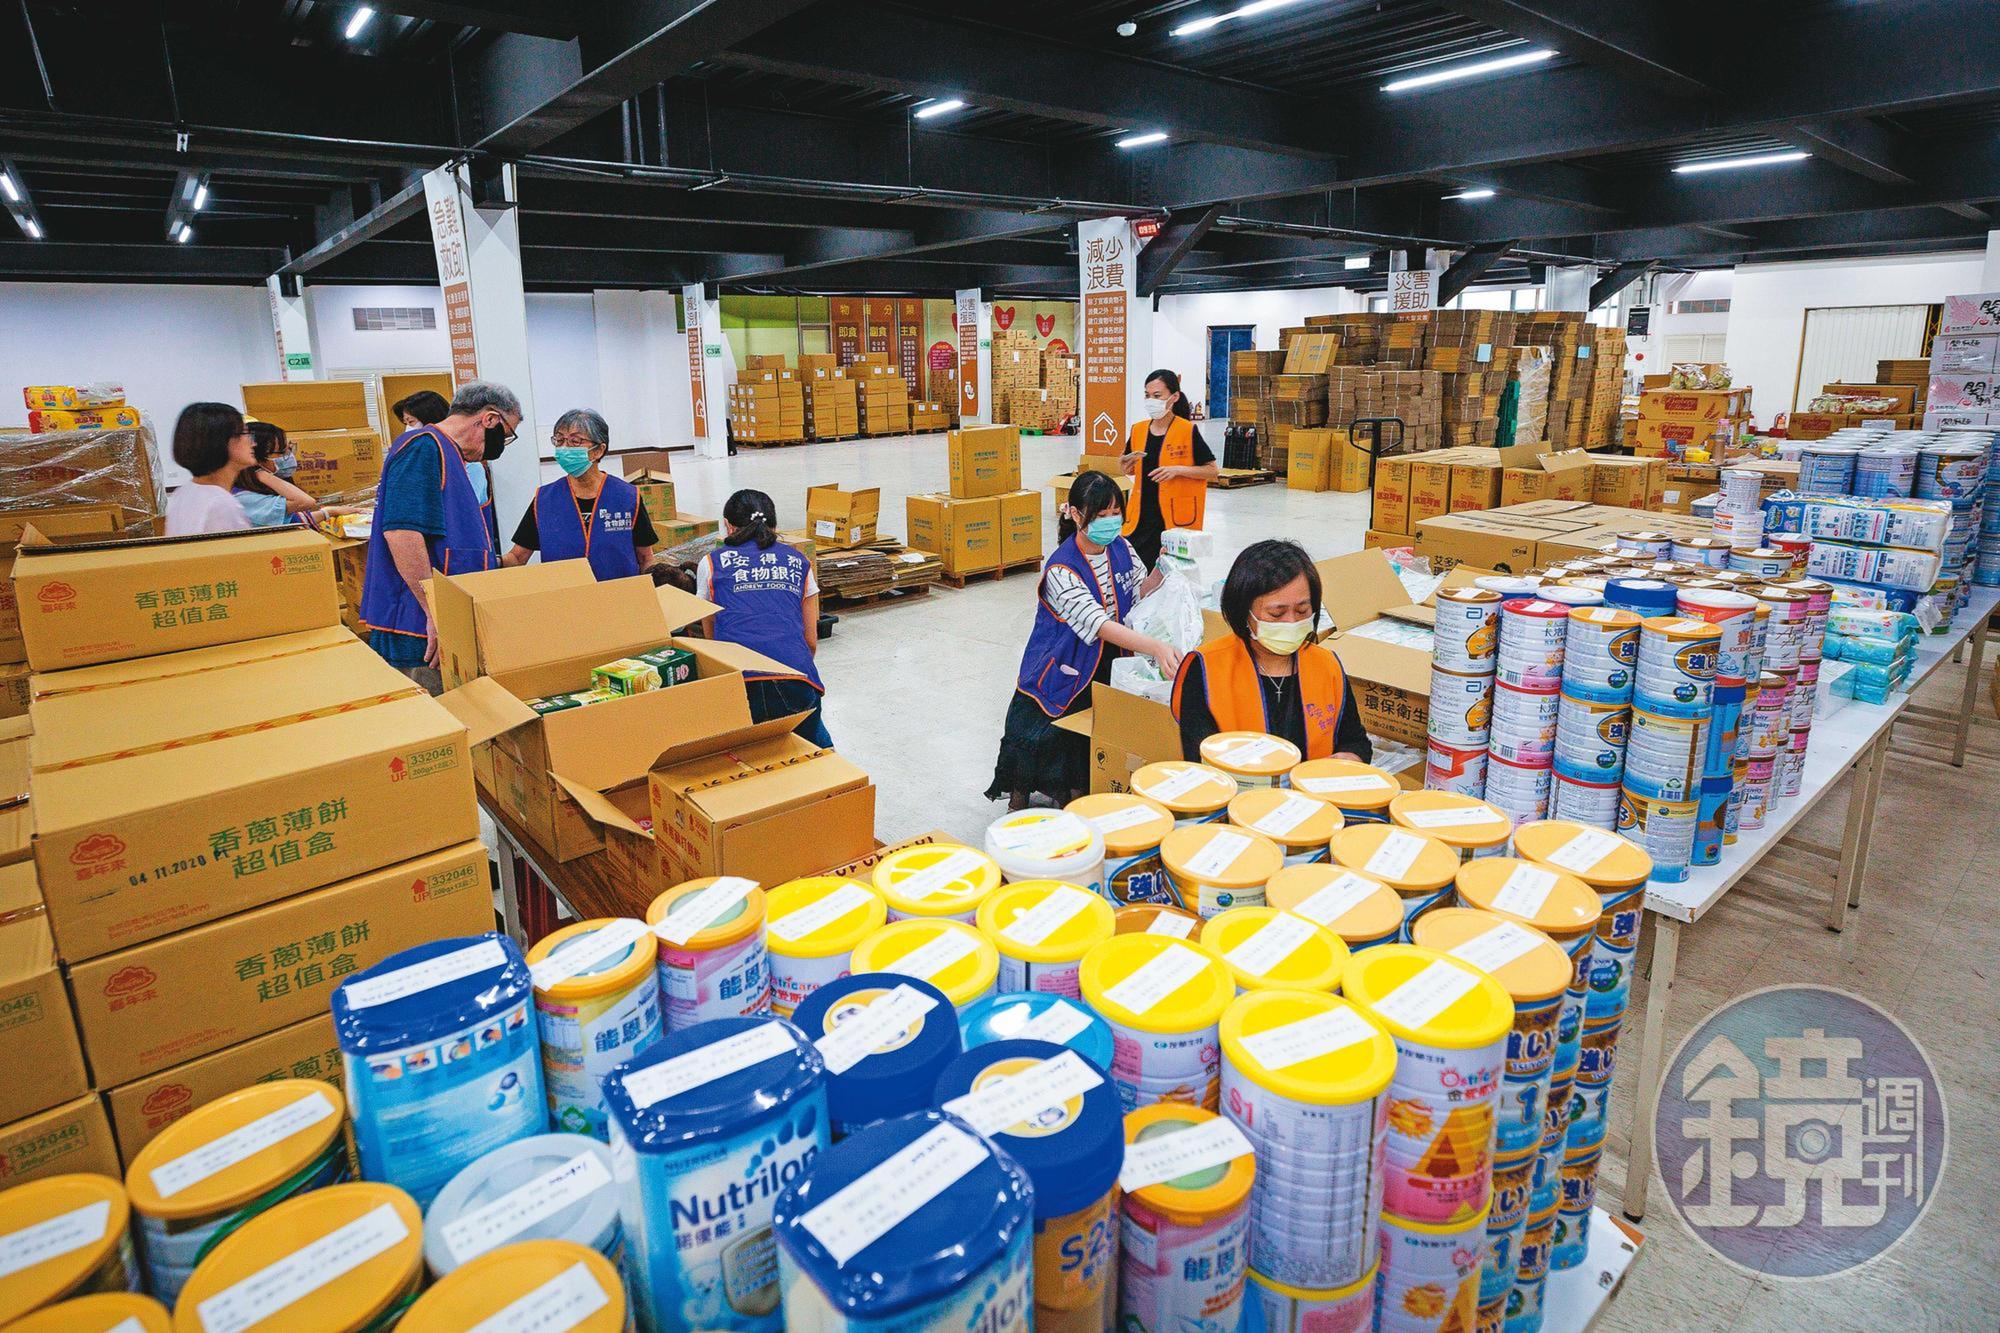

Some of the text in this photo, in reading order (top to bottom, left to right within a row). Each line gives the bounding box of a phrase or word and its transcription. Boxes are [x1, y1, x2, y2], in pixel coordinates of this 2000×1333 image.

[1086, 236, 1124, 263] 減少
[1086, 263, 1125, 290] 浪費
[1394, 271, 1430, 291] 災害
[1393, 291, 1430, 310] 援助
[733, 549, 803, 570] 安得烈
[733, 567, 803, 588] 食物銀行
[766, 583, 786, 591] FOOD
[134, 580, 240, 610] 香蔥薄餅
[151, 603, 230, 629] 超值盒
[1364, 694, 1428, 725] 環保衛生
[410, 746, 454, 766] 332046
[390, 770, 408, 783] UP
[208, 797, 349, 852] 香蔥薄餅
[232, 831, 337, 879] 超值盒
[432, 865, 476, 887] 332046
[412, 891, 430, 904] UP
[235, 919, 370, 982] 香蔥薄餅
[255, 953, 360, 1003] 超值盒
